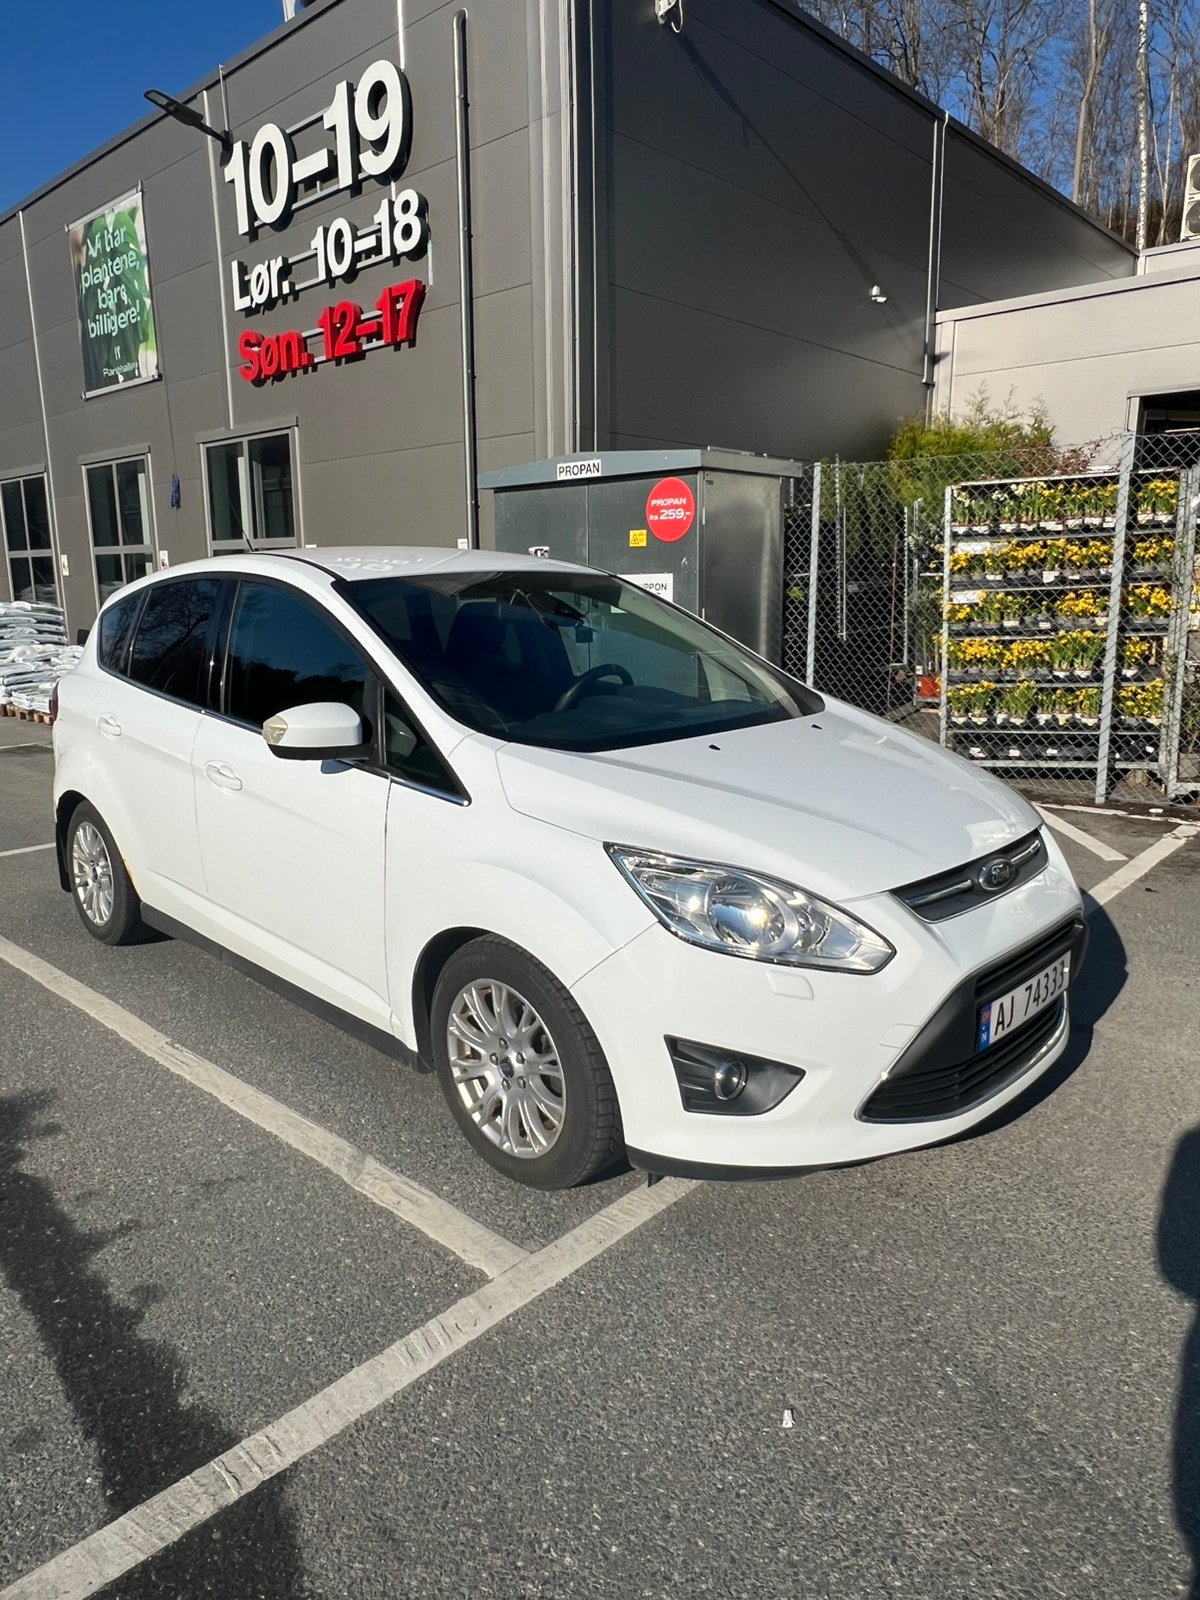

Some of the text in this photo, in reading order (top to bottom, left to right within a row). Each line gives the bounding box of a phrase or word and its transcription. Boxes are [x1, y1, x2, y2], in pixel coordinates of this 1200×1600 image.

[104, 225, 127, 252] har
[232, 255, 290, 311] Lør.
[87, 300, 141, 338] billigere!
[238, 328, 312, 382] Søn.
[558, 462, 600, 477] PROPAN
[651, 497, 687, 507] PROPAN
[660, 508, 691, 521] 259,-
[640, 582, 668, 591] PPON
[994, 960, 1065, 1036] AJ 74333
